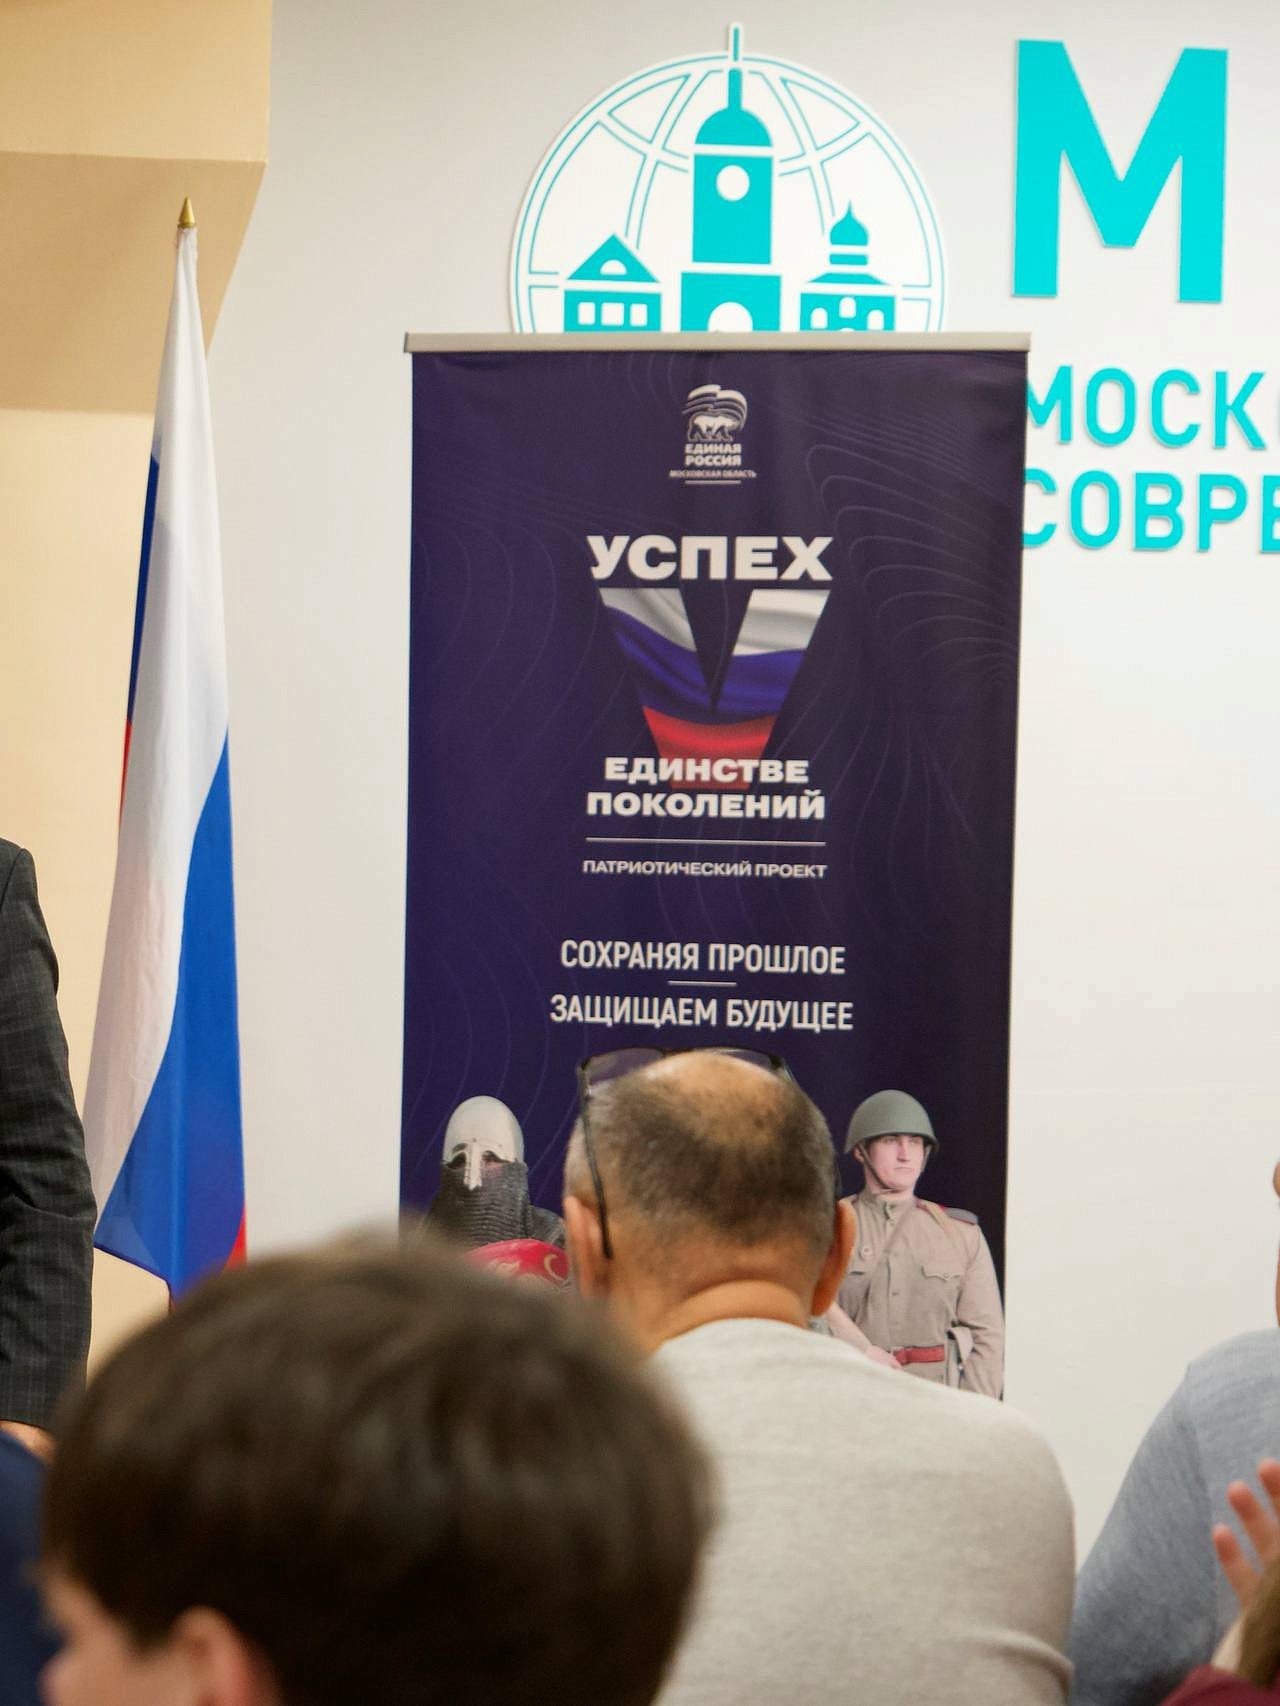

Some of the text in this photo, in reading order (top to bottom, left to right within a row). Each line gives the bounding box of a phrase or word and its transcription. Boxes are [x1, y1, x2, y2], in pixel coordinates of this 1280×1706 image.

[1026, 364, 1280, 449] МОСК
[685, 443, 742, 454] ЕДИНАЯ
[685, 455, 742, 466] РОССИЯ
[587, 534, 833, 581] УСПЕХ
[605, 757, 809, 785] ЕДИНСТВЕ
[587, 789, 825, 820] ПОКОЛЕНИЙ
[583, 860, 828, 879] ПАТРИОТИЧЕСКИЙ ПРОЕКТ
[561, 939, 846, 975] СОХРАНЯЯ ПРОШЛОЕ
[550, 994, 854, 1034] ЗАЩИЩАЕМ БУДУЩЕЕ
